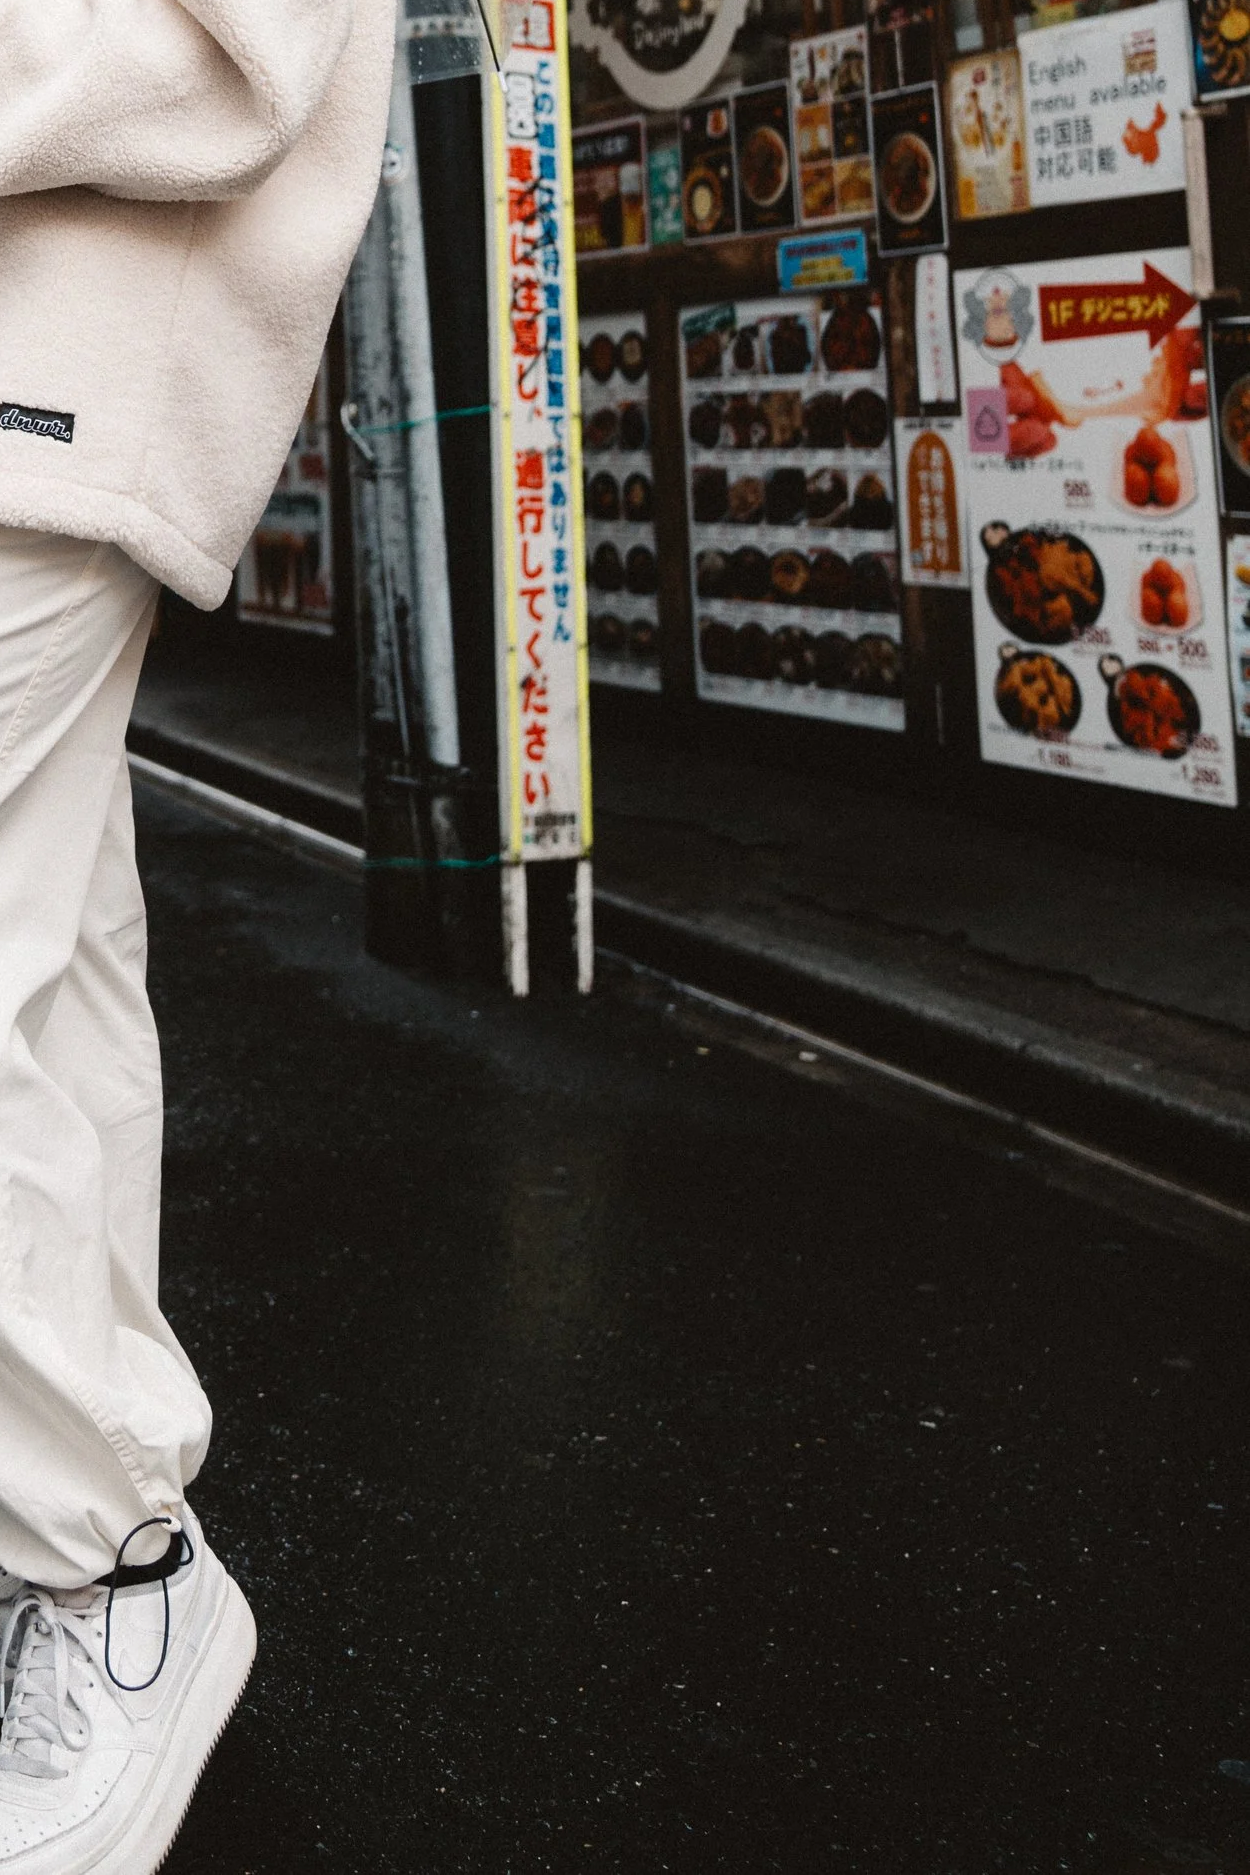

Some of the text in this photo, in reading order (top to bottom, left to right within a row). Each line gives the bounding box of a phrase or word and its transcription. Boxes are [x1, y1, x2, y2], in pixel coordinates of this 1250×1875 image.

[1028, 55, 1086, 86] English
[1031, 73, 1167, 115] menu available
[1034, 116, 1093, 148] 中国語
[1048, 299, 1076, 327] 1F
